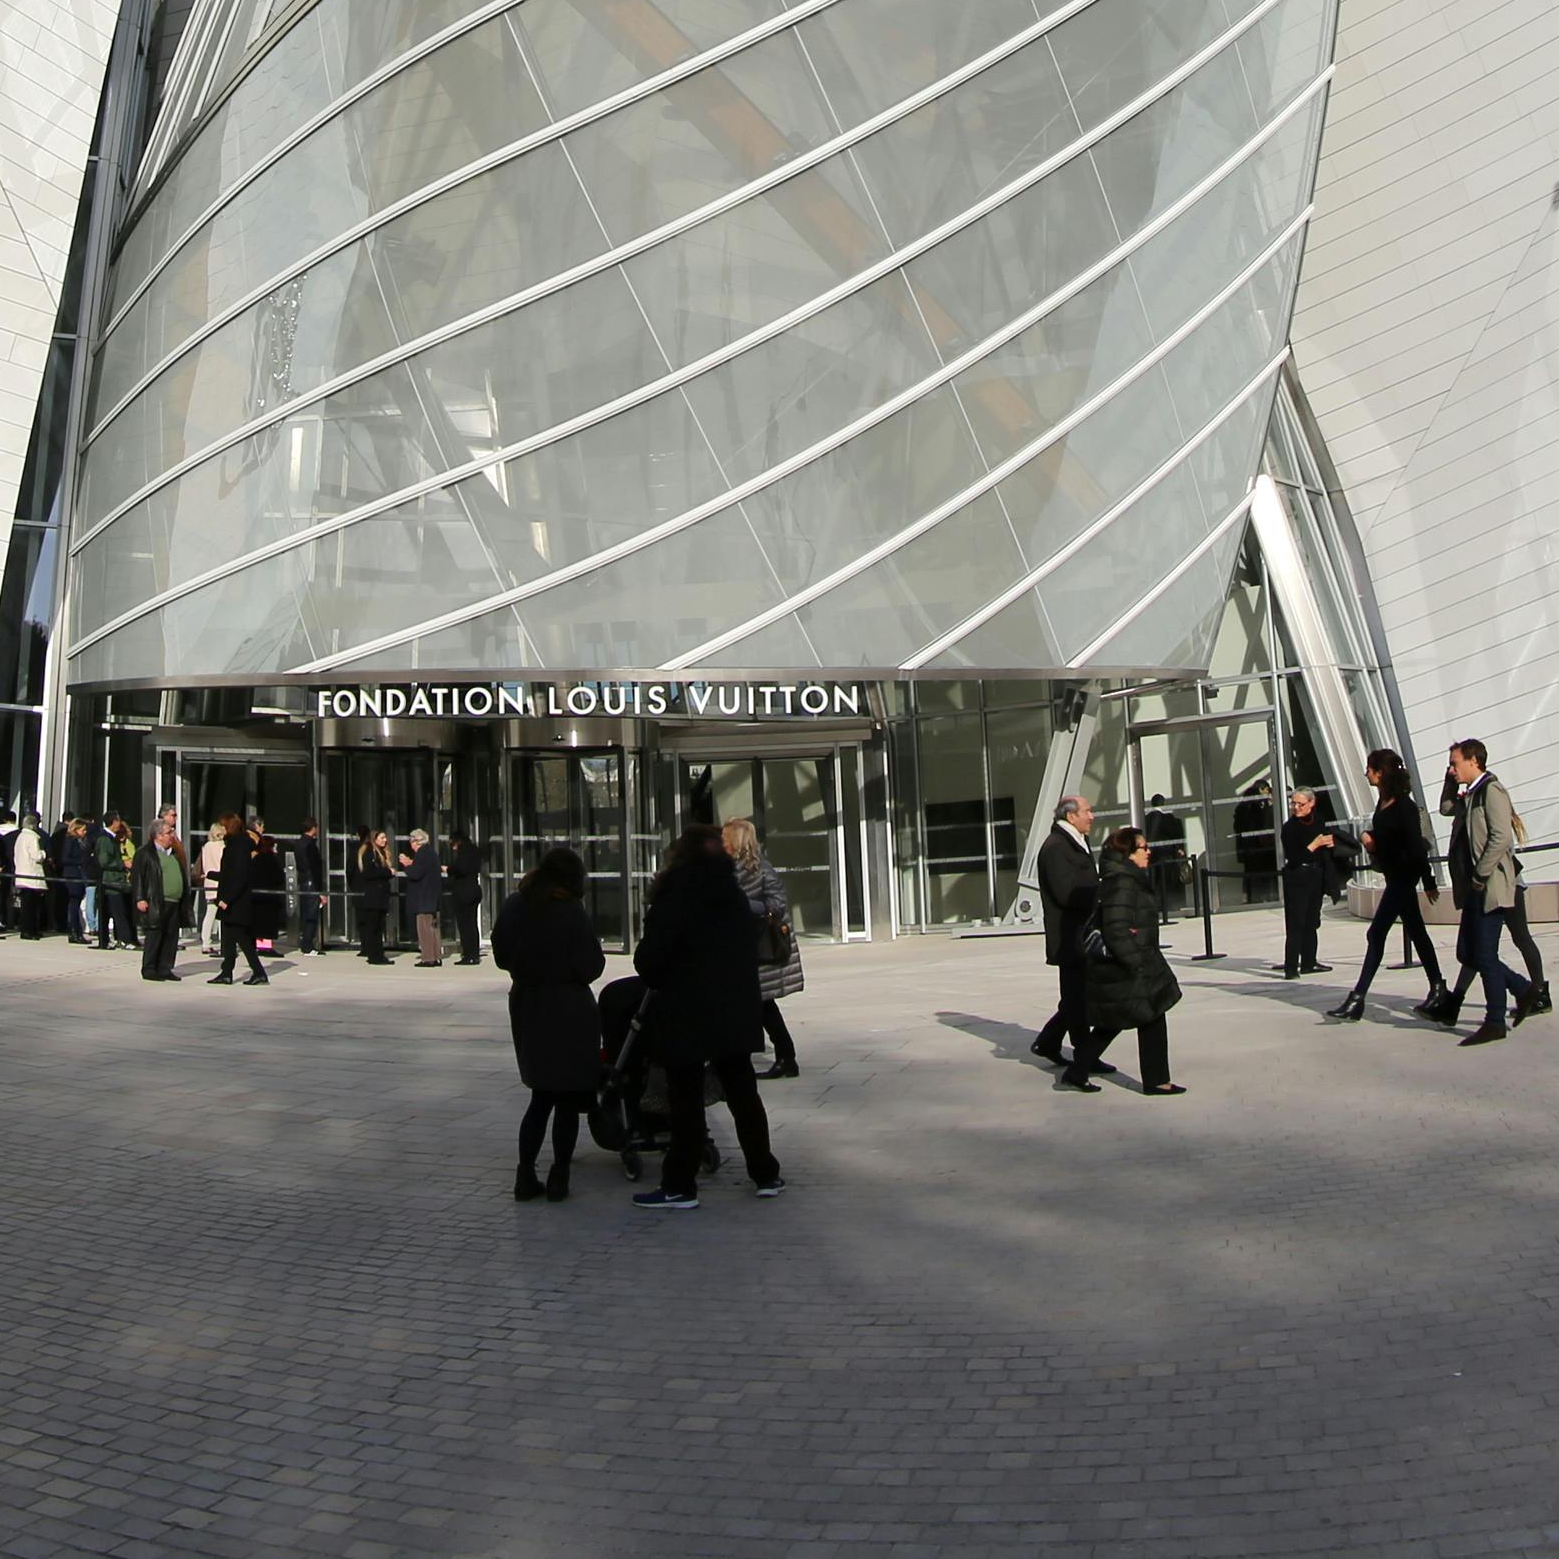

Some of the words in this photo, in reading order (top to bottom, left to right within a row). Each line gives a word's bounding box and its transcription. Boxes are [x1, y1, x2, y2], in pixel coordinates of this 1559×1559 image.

[317, 686, 524, 718] FONDATION
[548, 685, 668, 716] LOUIS
[688, 685, 859, 716] VUITTON
